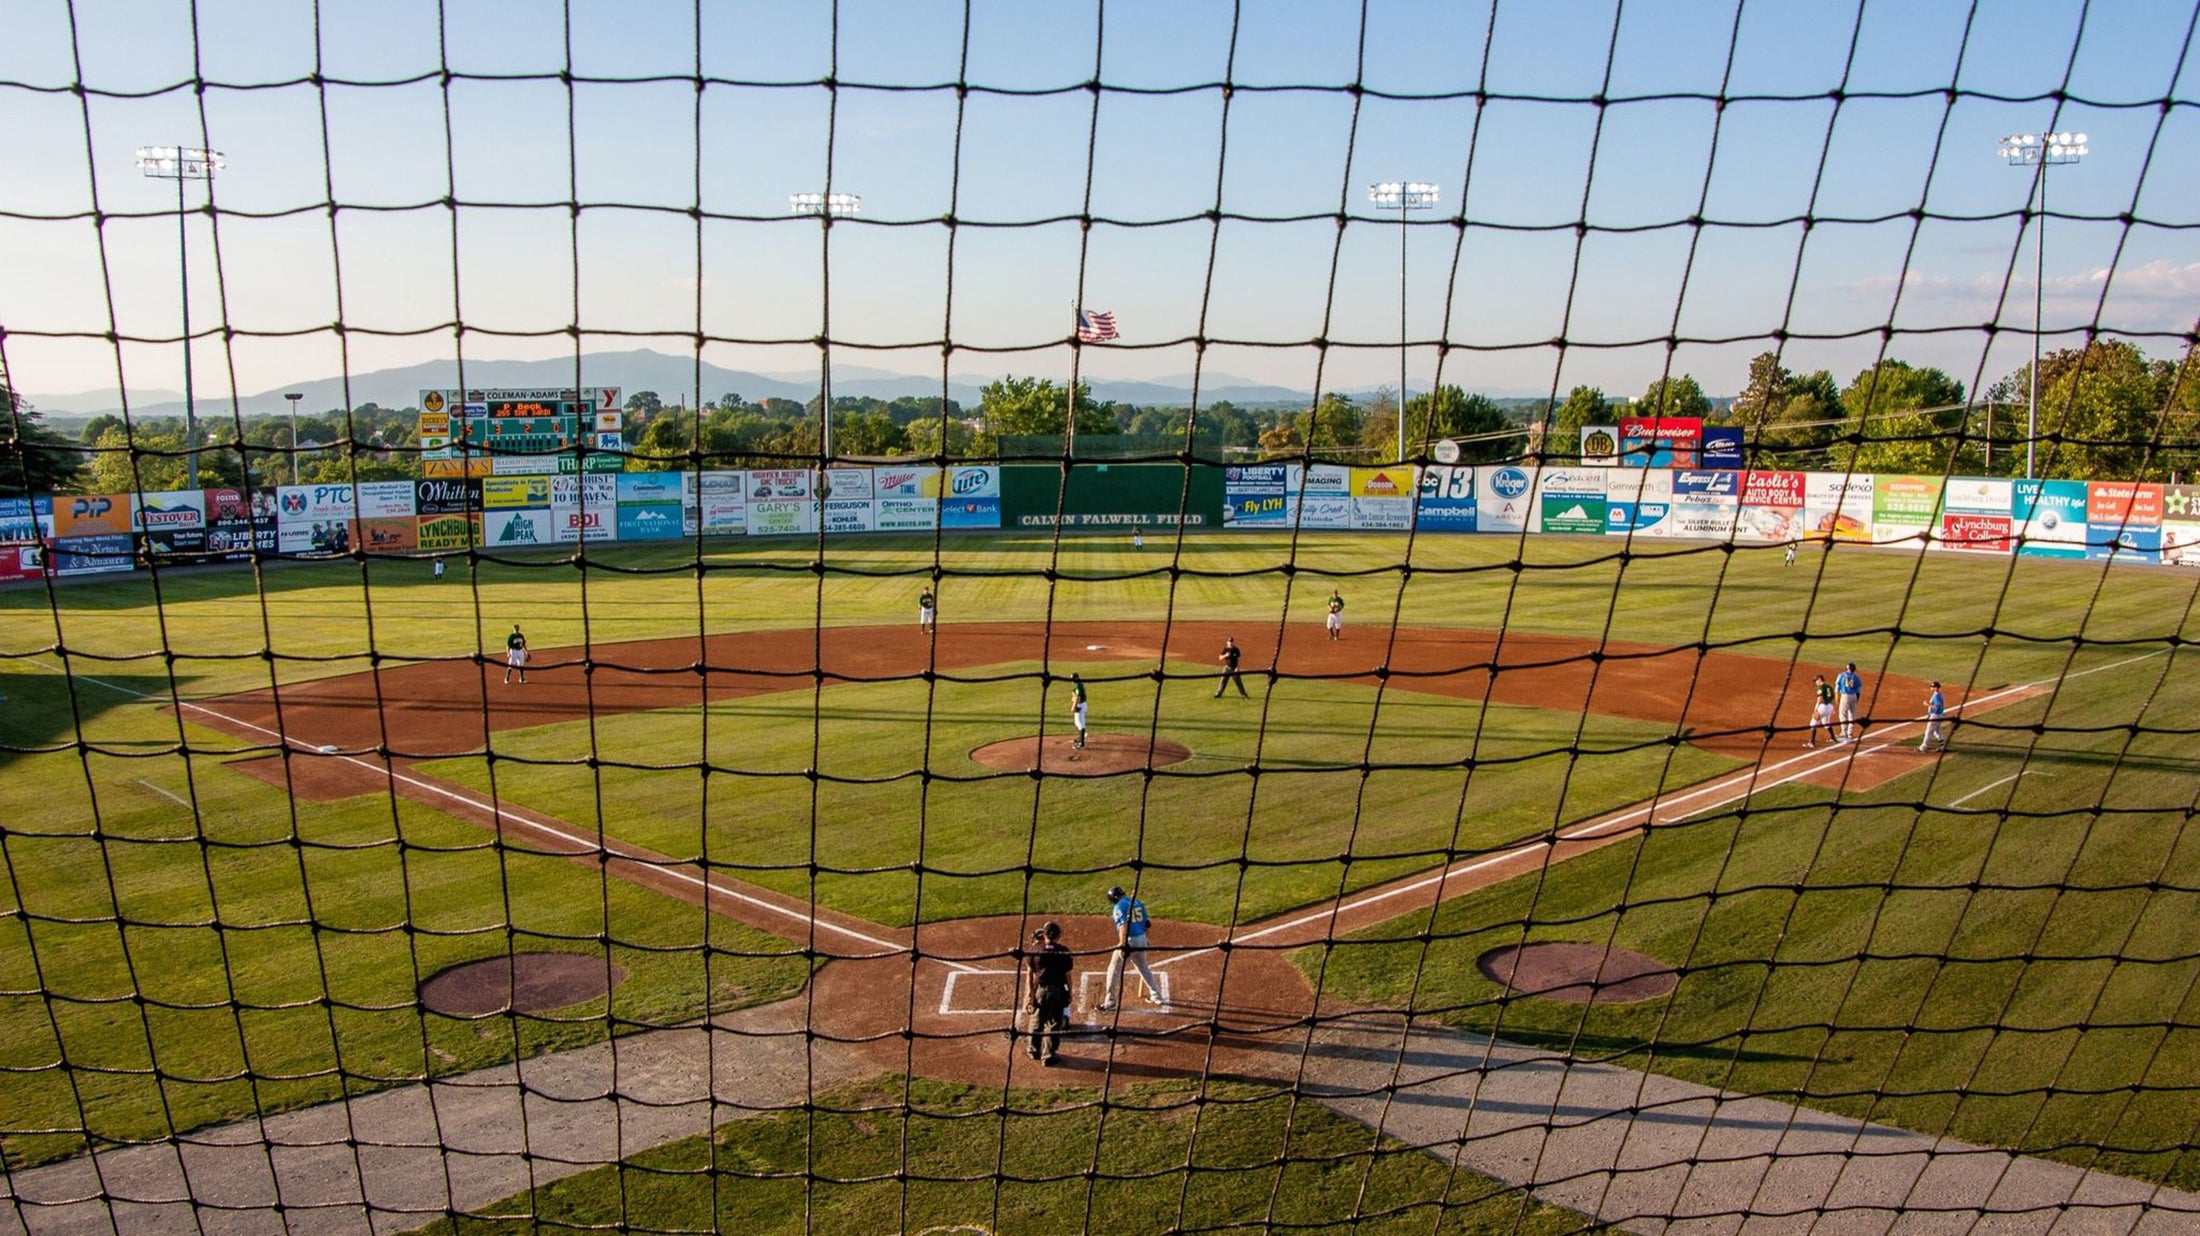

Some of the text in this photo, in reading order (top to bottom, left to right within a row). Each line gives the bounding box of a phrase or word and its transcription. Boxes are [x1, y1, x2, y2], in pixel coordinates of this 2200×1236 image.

[313, 485, 352, 505] PTC
[756, 502, 801, 513] GARY'S
[1262, 497, 1283, 511] LYH
[1081, 514, 1150, 524] FALWELL
